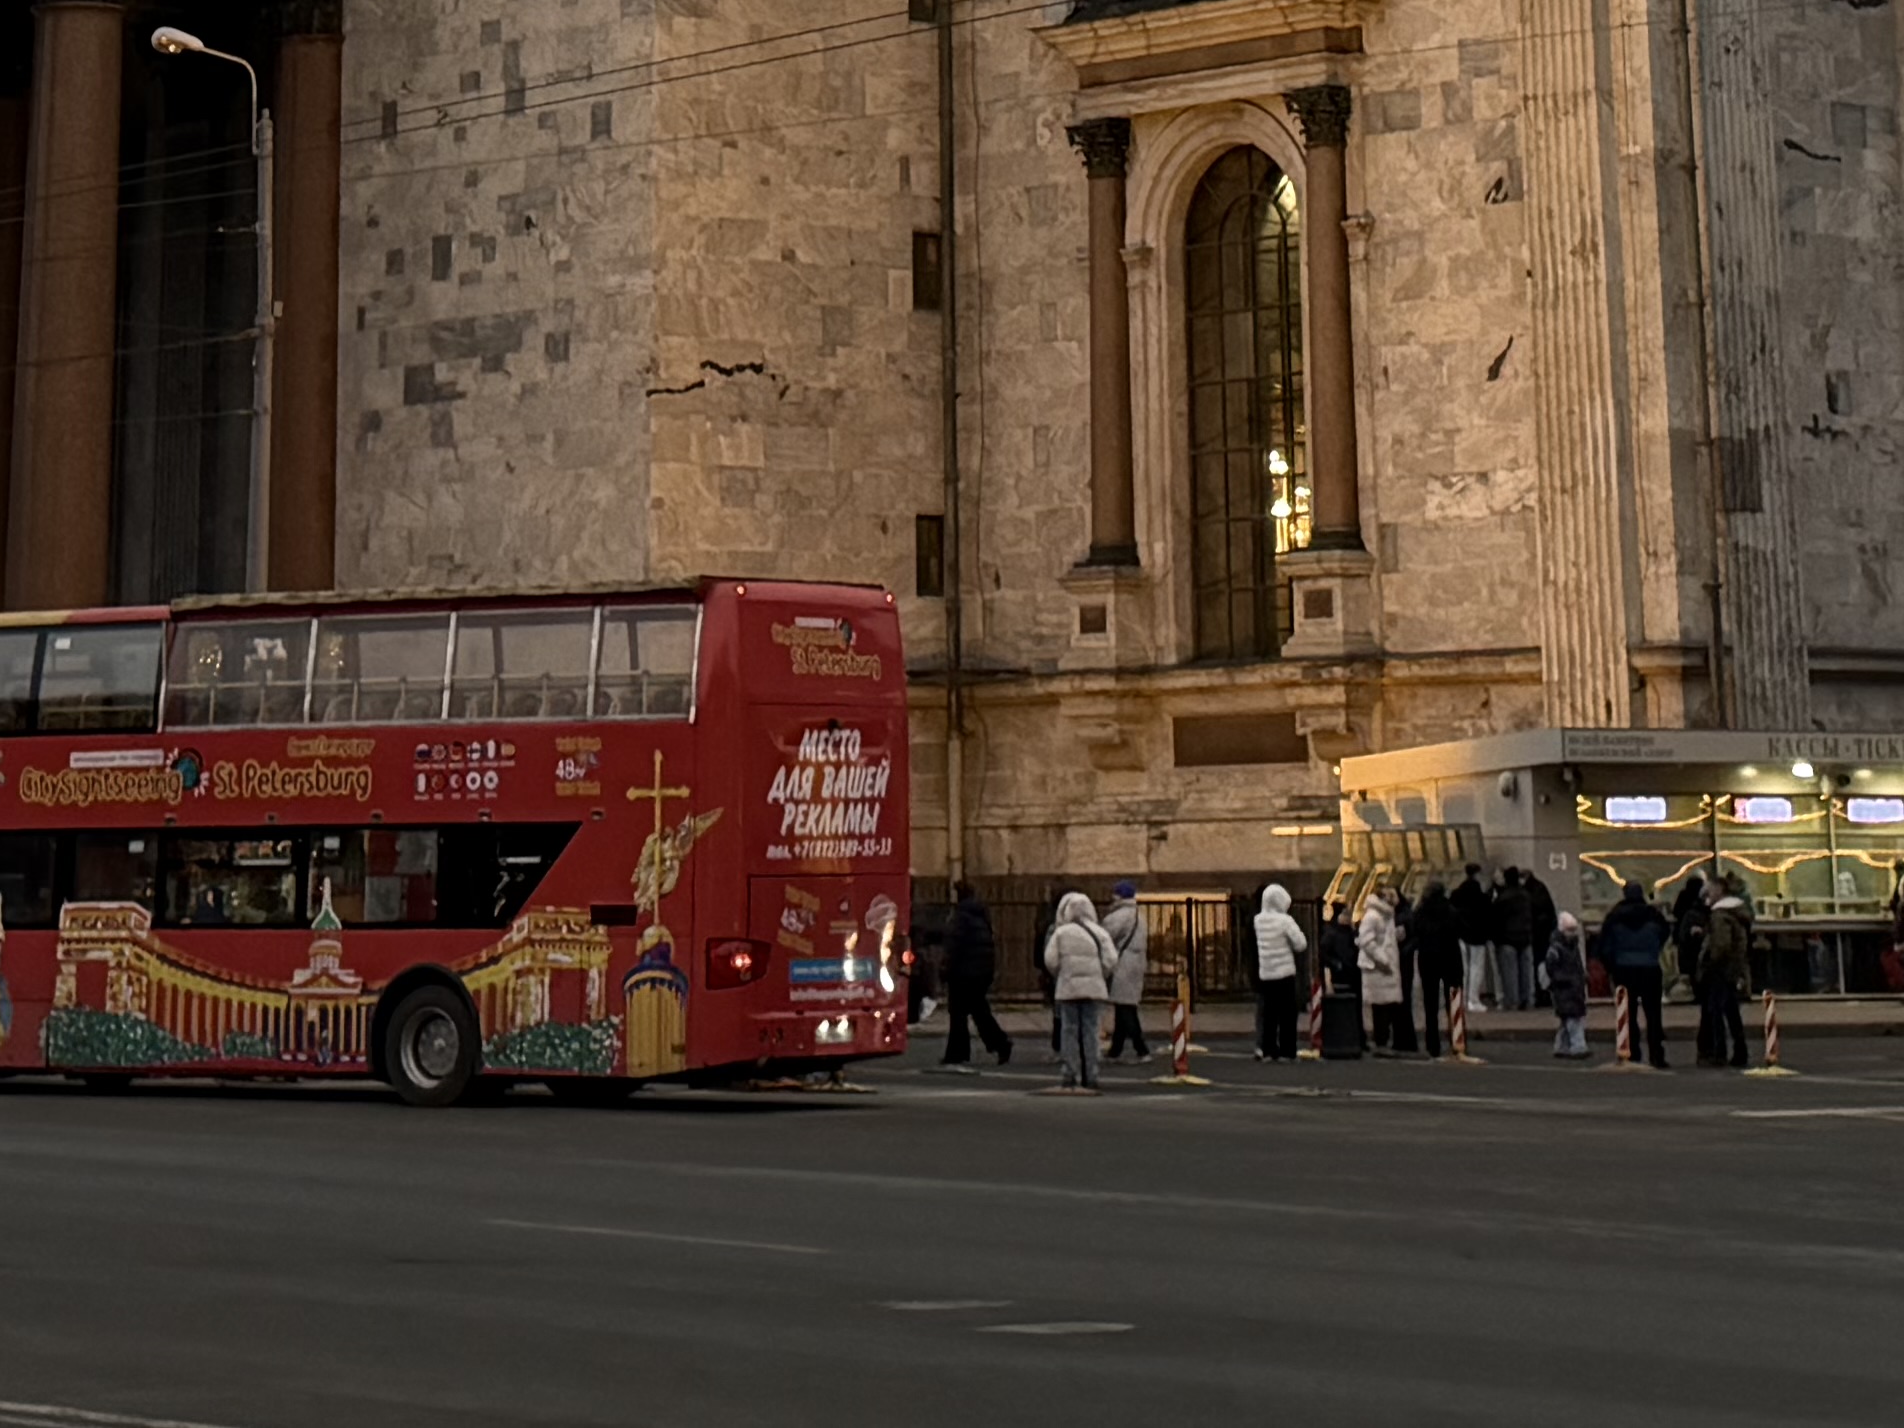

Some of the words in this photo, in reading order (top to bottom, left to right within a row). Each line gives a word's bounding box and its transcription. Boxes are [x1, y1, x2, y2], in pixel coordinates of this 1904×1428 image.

[798, 728, 861, 762] МЕСТО
[1768, 737, 1839, 758] КАССЫ
[213, 760, 239, 799] St
[242, 758, 372, 801] Petersburg
[766, 764, 815, 804] ДЛЯ
[821, 757, 891, 799] ВАШЕЙ
[780, 801, 880, 837] РЕКЛАМЫ
